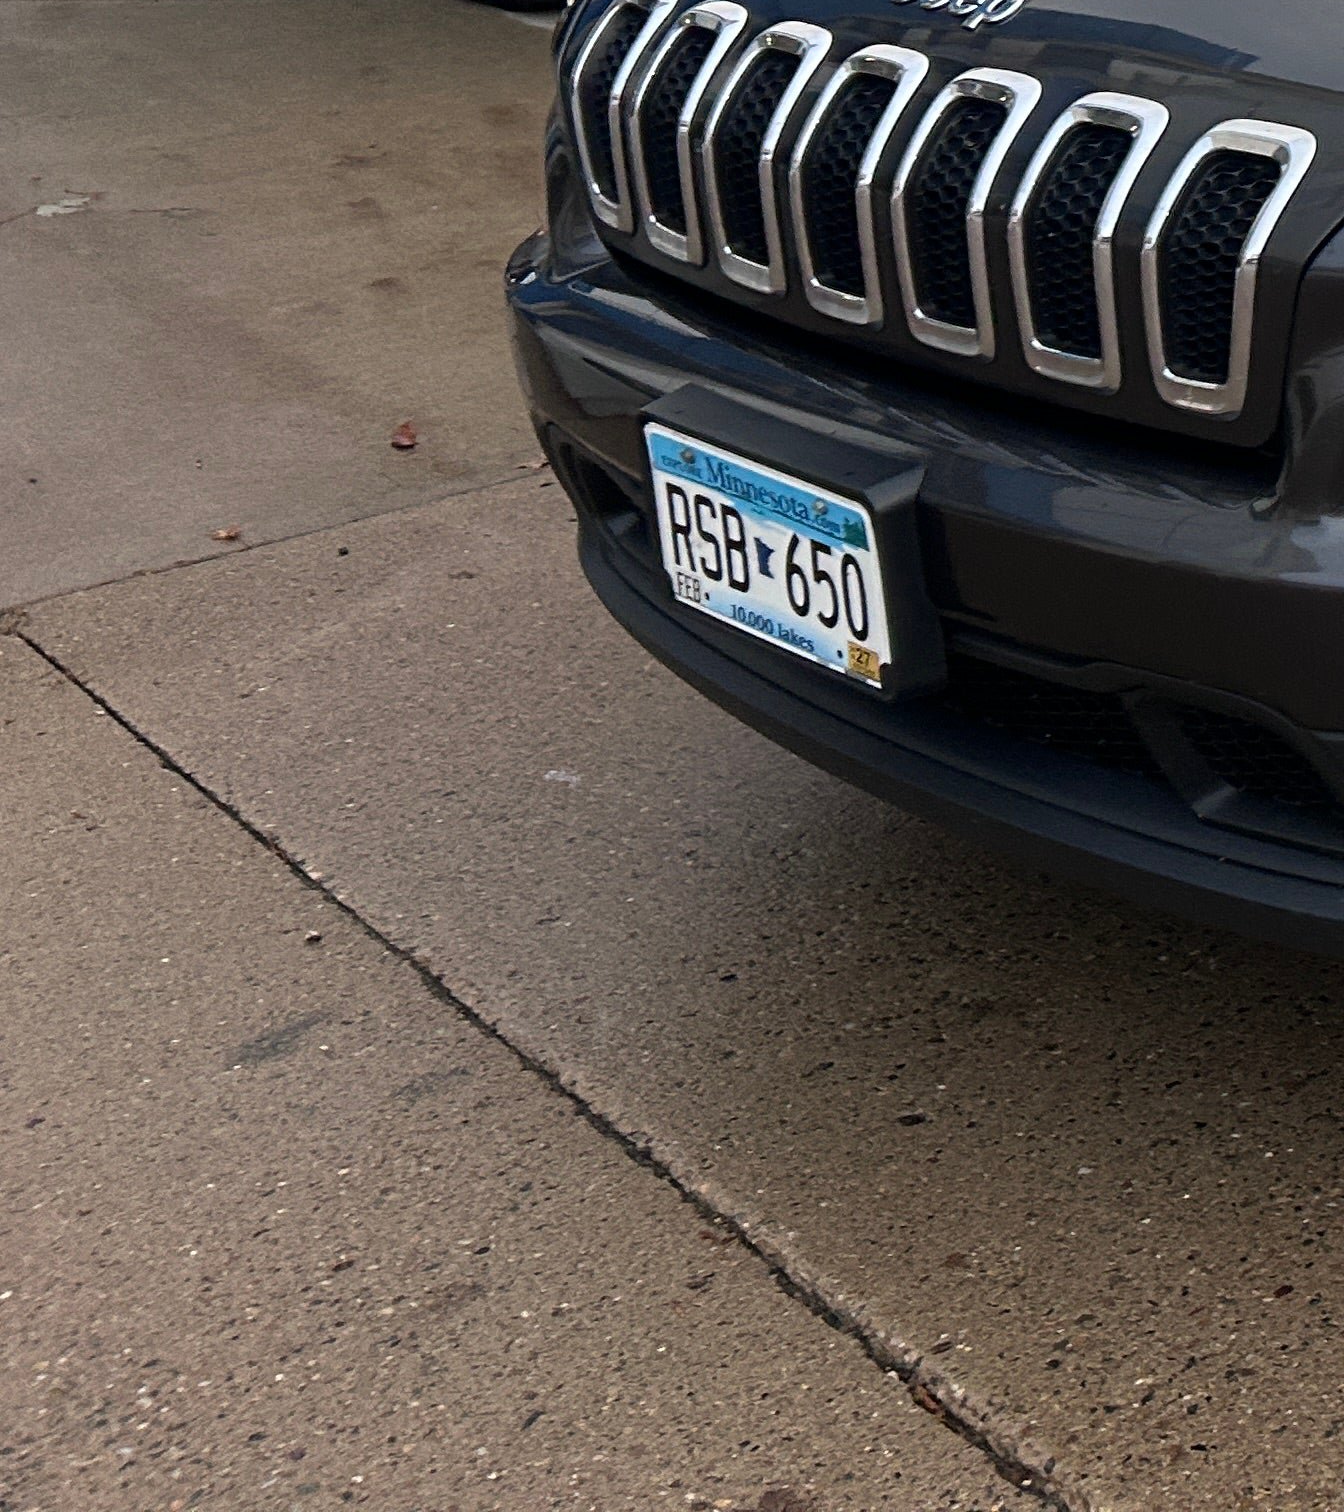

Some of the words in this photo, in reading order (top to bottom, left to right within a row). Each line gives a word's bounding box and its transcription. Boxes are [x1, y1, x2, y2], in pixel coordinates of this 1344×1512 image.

[704, 456, 810, 520] Minnesota
[666, 482, 750, 593] RSB
[786, 534, 869, 642] 650
[677, 571, 701, 604] FEB
[777, 623, 816, 653] lakes
